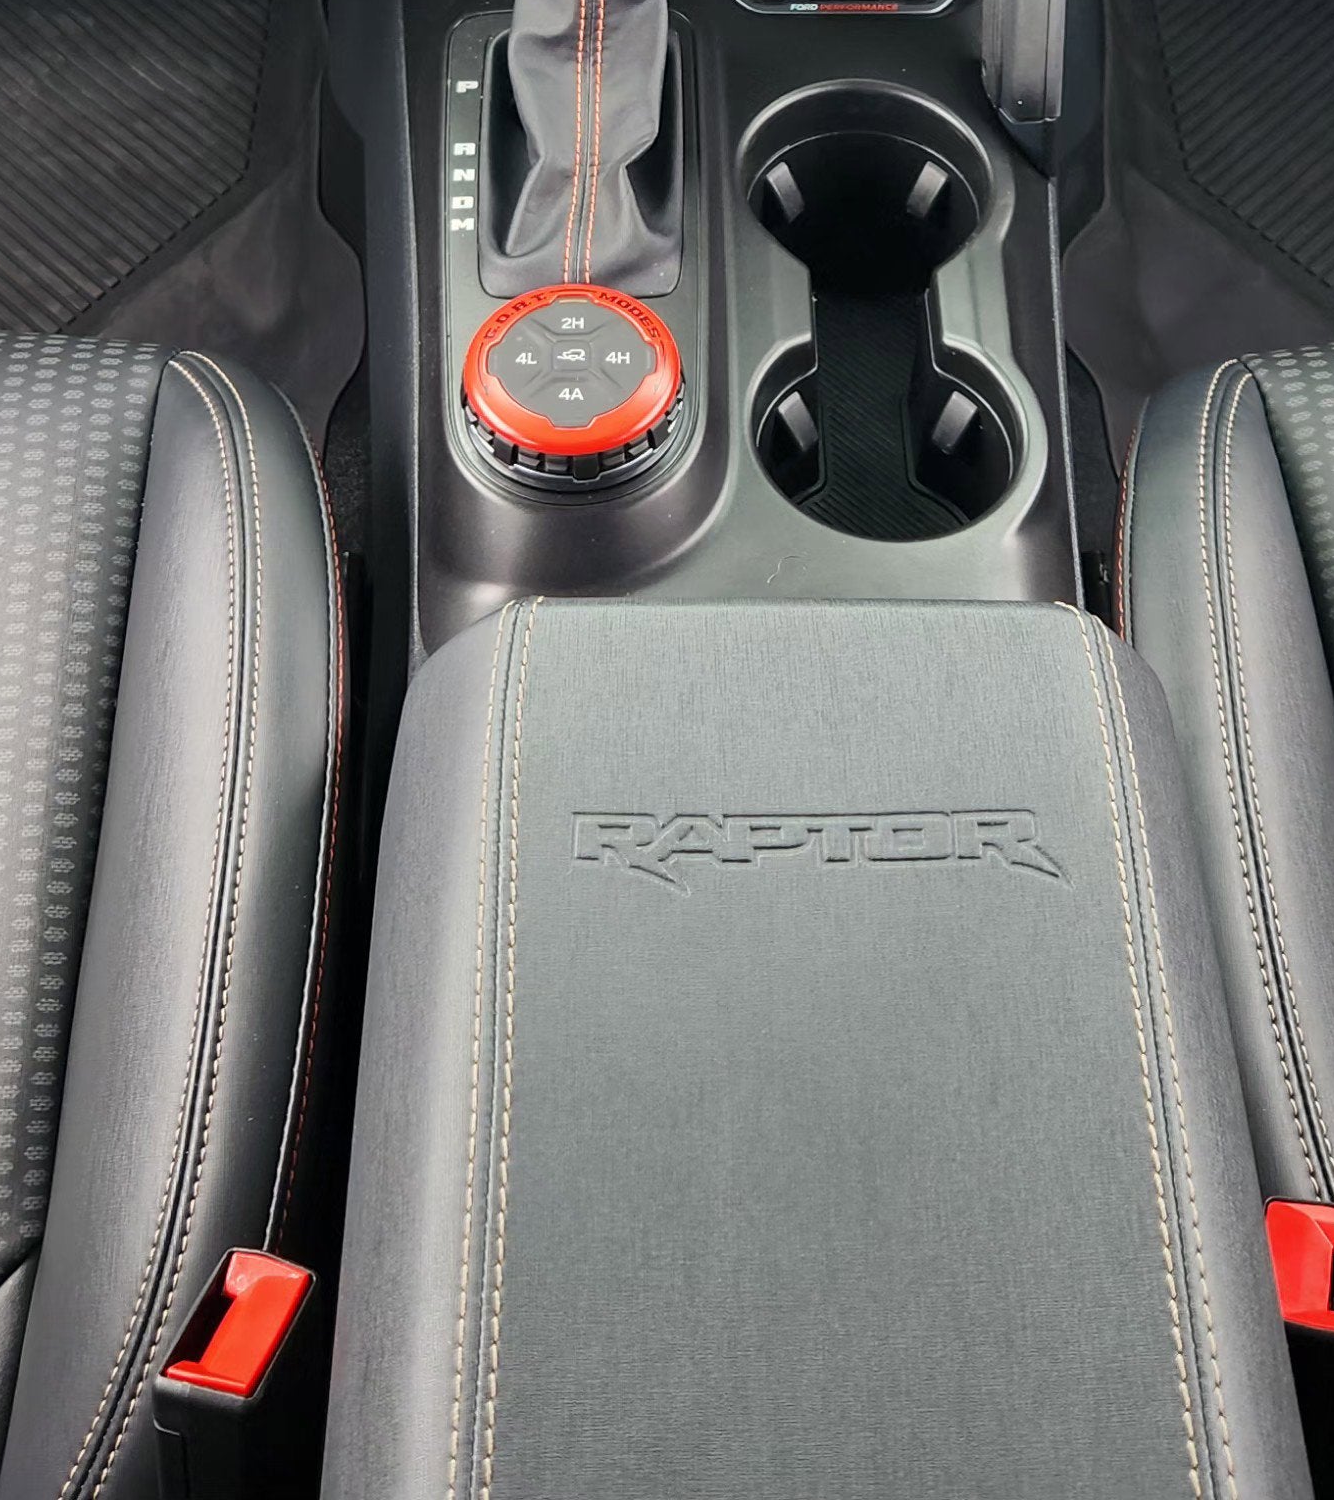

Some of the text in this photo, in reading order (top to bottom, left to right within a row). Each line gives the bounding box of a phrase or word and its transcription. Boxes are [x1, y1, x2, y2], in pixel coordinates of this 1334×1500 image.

[790, 3, 898, 12] FORD PERFORMANCE
[456, 80, 479, 93] P
[453, 142, 476, 156] R
[453, 168, 475, 181] N
[452, 196, 474, 209] D
[451, 218, 474, 231] M
[598, 292, 661, 339] MODES
[561, 317, 585, 329] 2H
[515, 352, 537, 364] 4L
[605, 352, 630, 364] 4H
[558, 388, 584, 400] 4A
[571, 809, 1074, 898] RAPTOR
